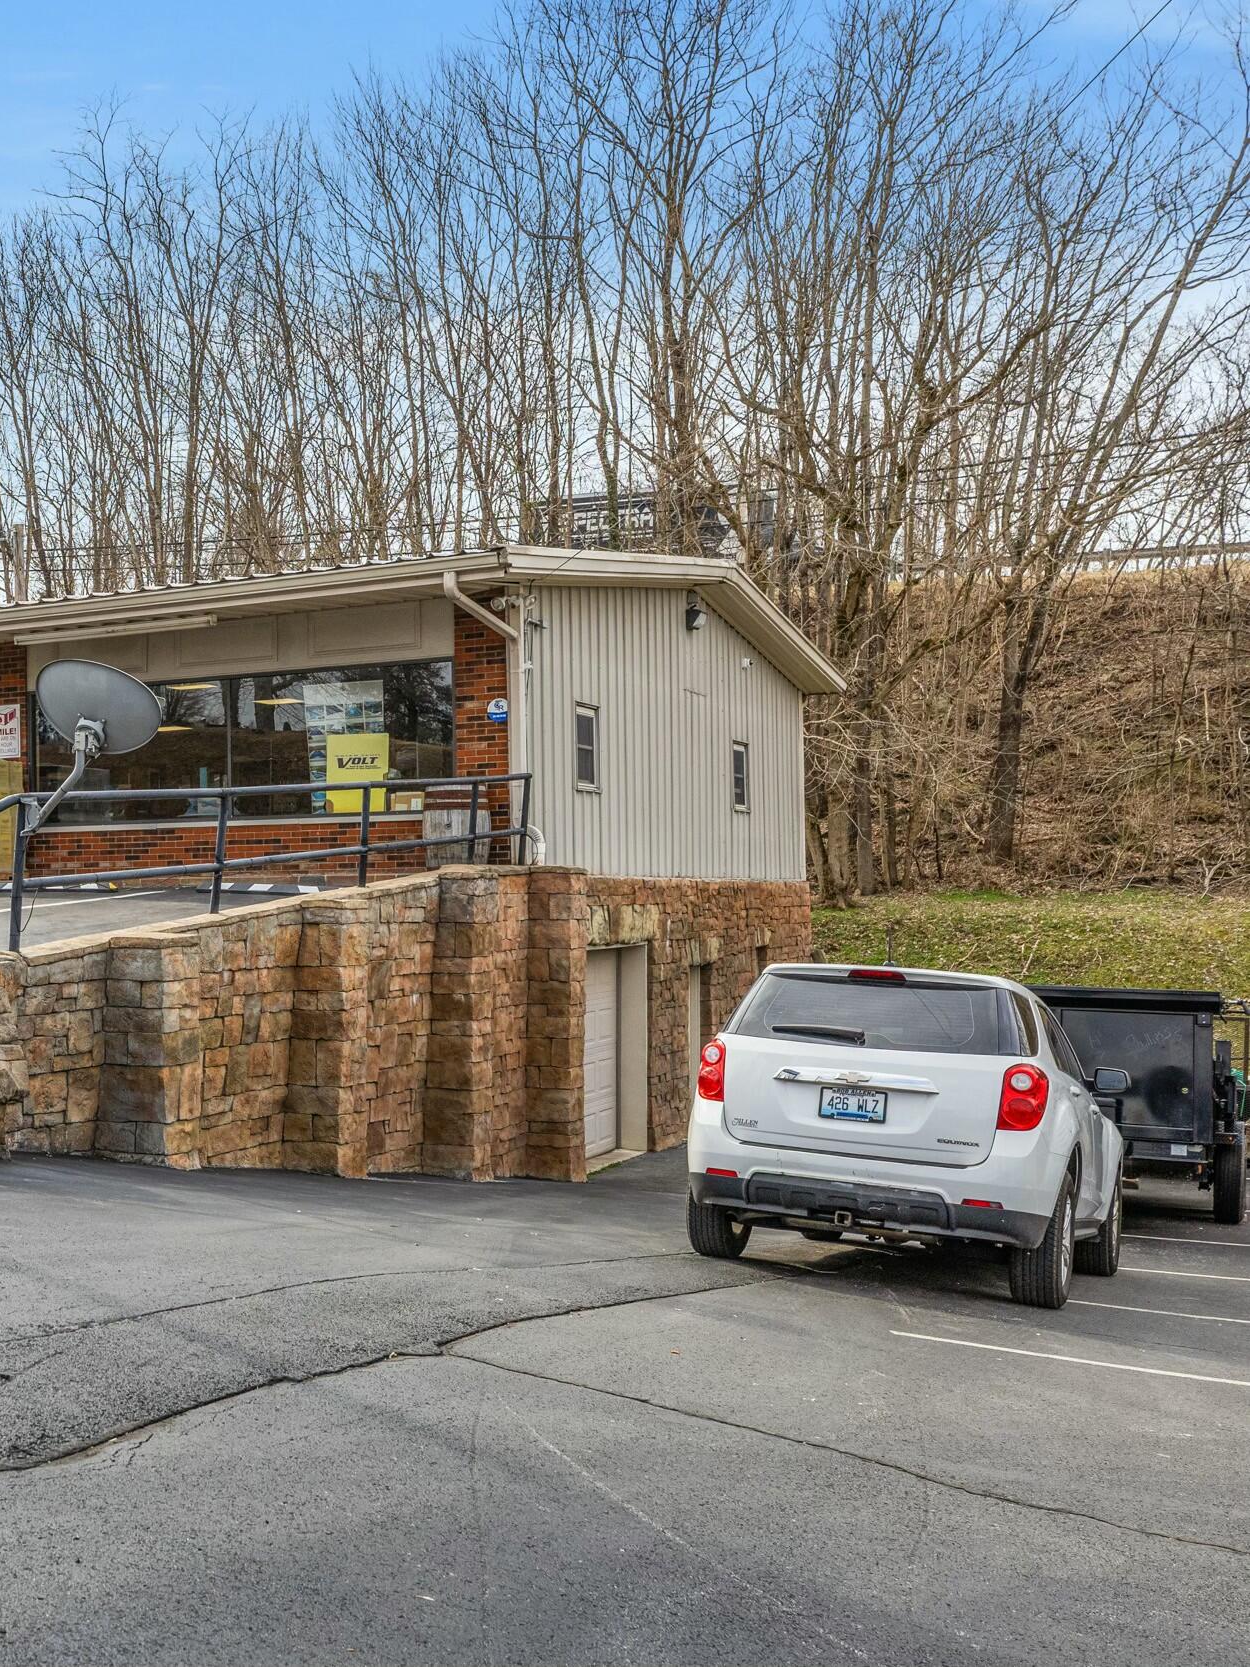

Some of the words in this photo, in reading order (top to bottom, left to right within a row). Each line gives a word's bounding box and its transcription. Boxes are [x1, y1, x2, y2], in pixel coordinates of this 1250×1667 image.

[337, 757, 379, 769] VOLT
[827, 1096, 849, 1111] 426
[857, 1098, 879, 1114] WLZ
[936, 1137, 980, 1148] EQUINOX
